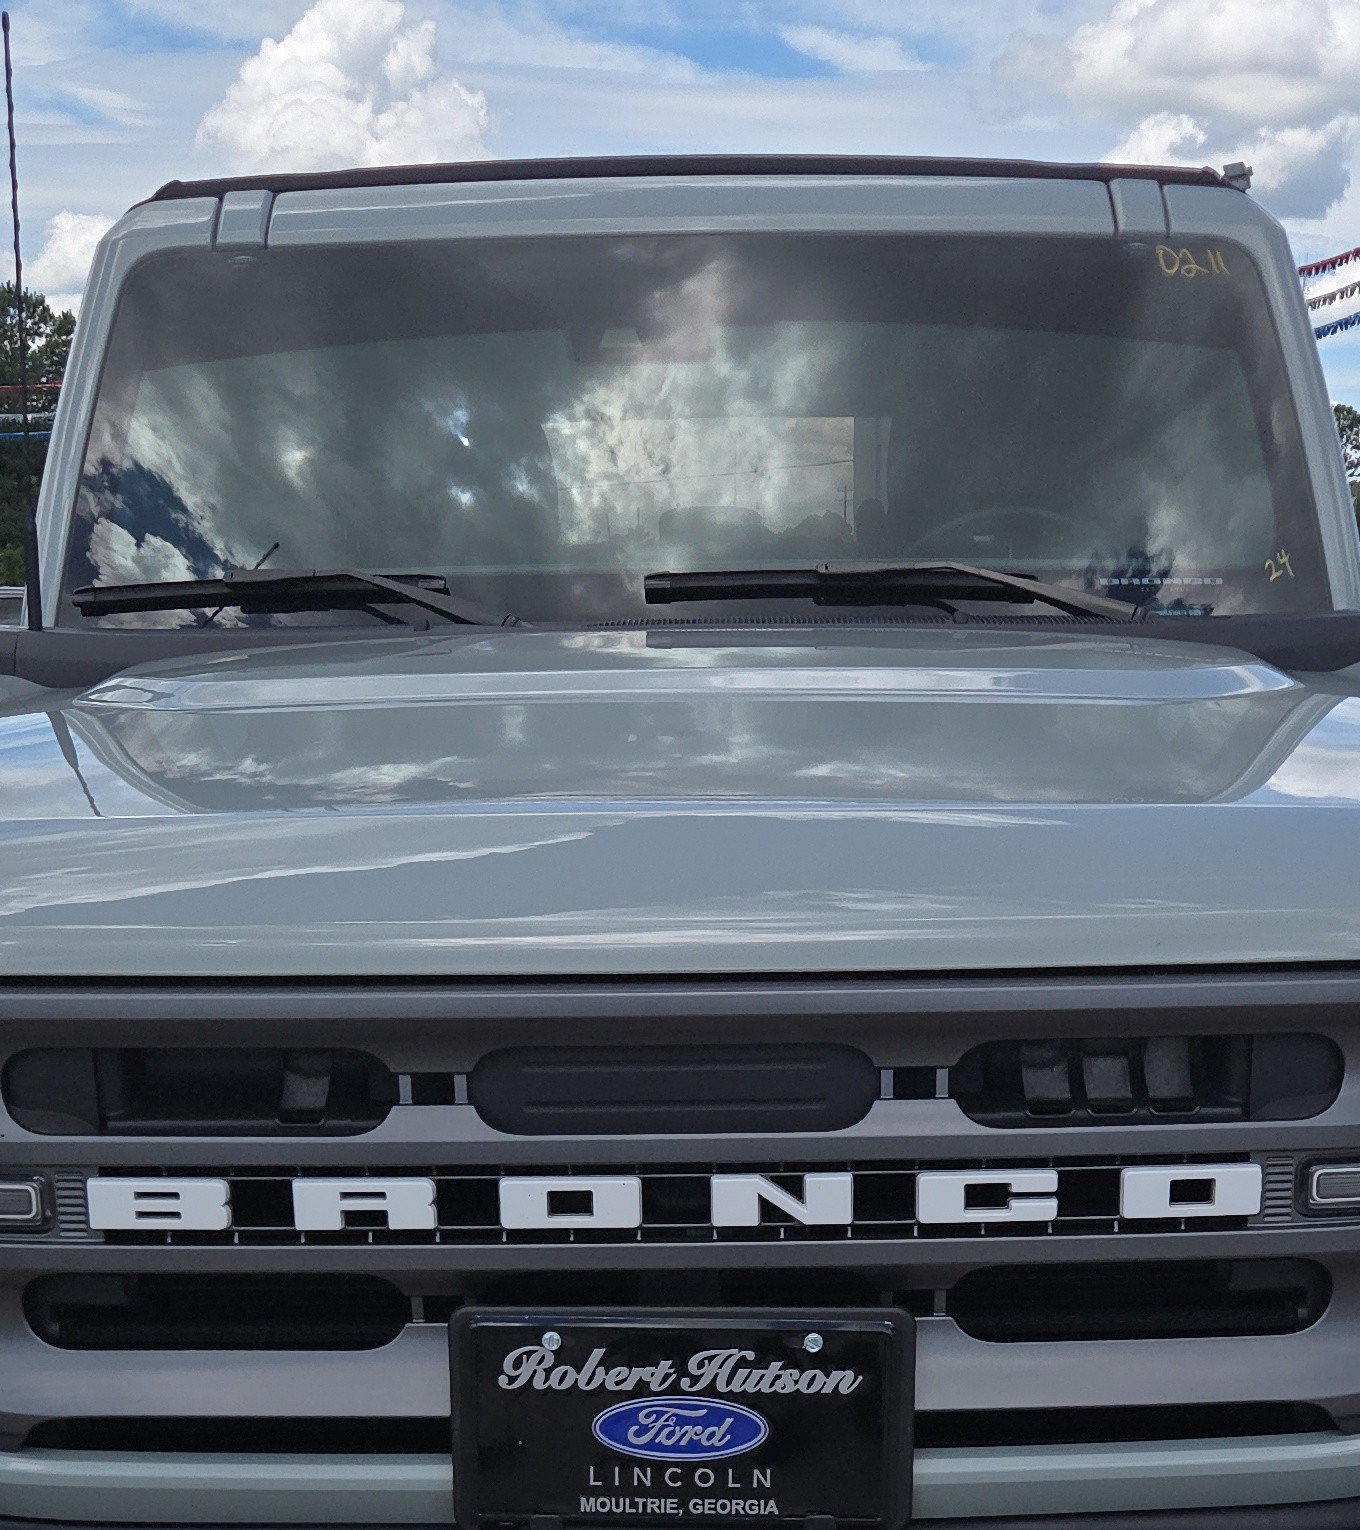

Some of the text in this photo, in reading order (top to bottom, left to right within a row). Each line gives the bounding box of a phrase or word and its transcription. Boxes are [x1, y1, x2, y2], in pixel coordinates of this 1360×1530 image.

[1264, 549, 1295, 582] 24
[86, 1163, 1262, 1231] BRONCO
[498, 1345, 863, 1394] Robert Hutson
[627, 1406, 734, 1448] Ford
[589, 1466, 772, 1488] LINCOLN
[579, 1497, 779, 1517] MOULTRIE, GEORGIA
